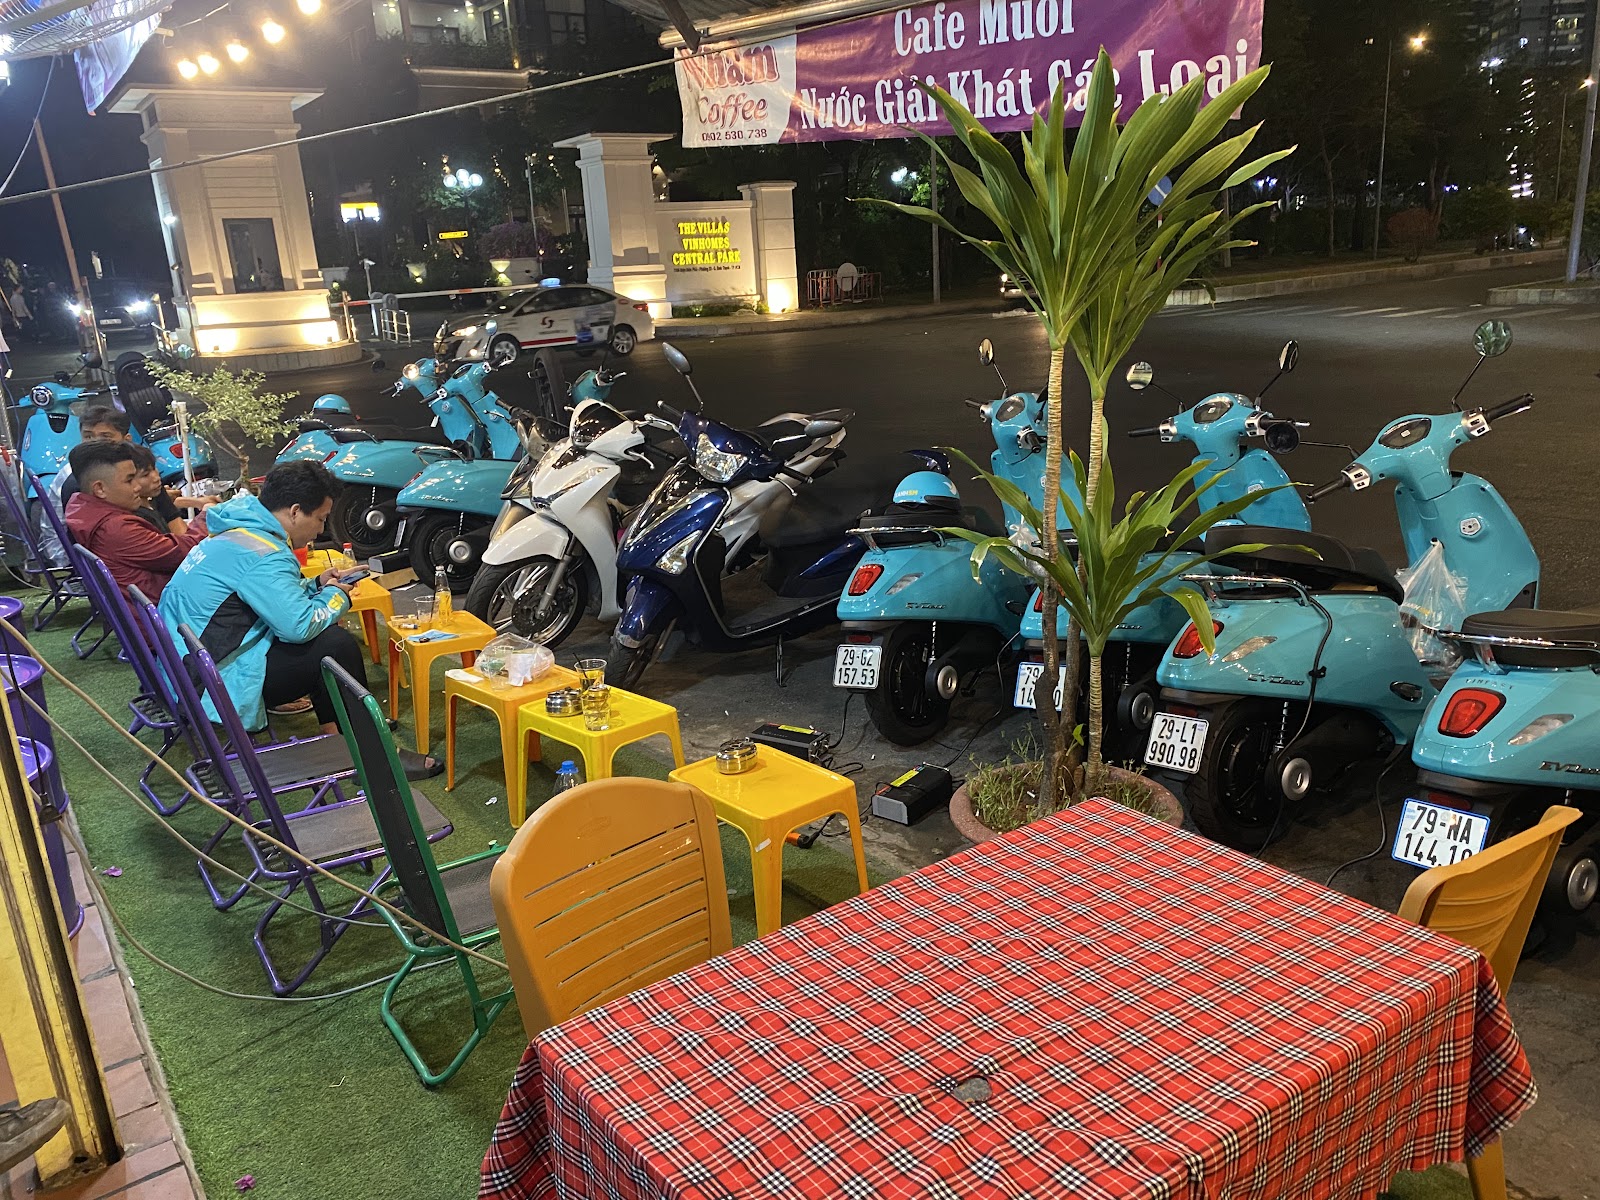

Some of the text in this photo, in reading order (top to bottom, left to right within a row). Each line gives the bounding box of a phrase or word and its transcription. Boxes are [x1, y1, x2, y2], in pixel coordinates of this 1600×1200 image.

[894, 2, 965, 57] Cafe
[697, 92, 769, 129] Coffee
[800, 85, 867, 130] Nước
[875, 75, 938, 125] Giải
[947, 68, 1036, 120] Khát
[725, 130, 744, 141] 530
[747, 128, 768, 139] 738
[677, 221, 731, 235] THE VILLAS
[682, 236, 730, 250] VINHOMES
[672, 250, 741, 266] CENTRAL PARK
[842, 648, 874, 667] 29-G2
[838, 667, 876, 686] 157.53
[1157, 718, 1198, 745] 29-L1
[1148, 740, 1198, 770] 990.98
[1412, 805, 1473, 845] 79-NA
